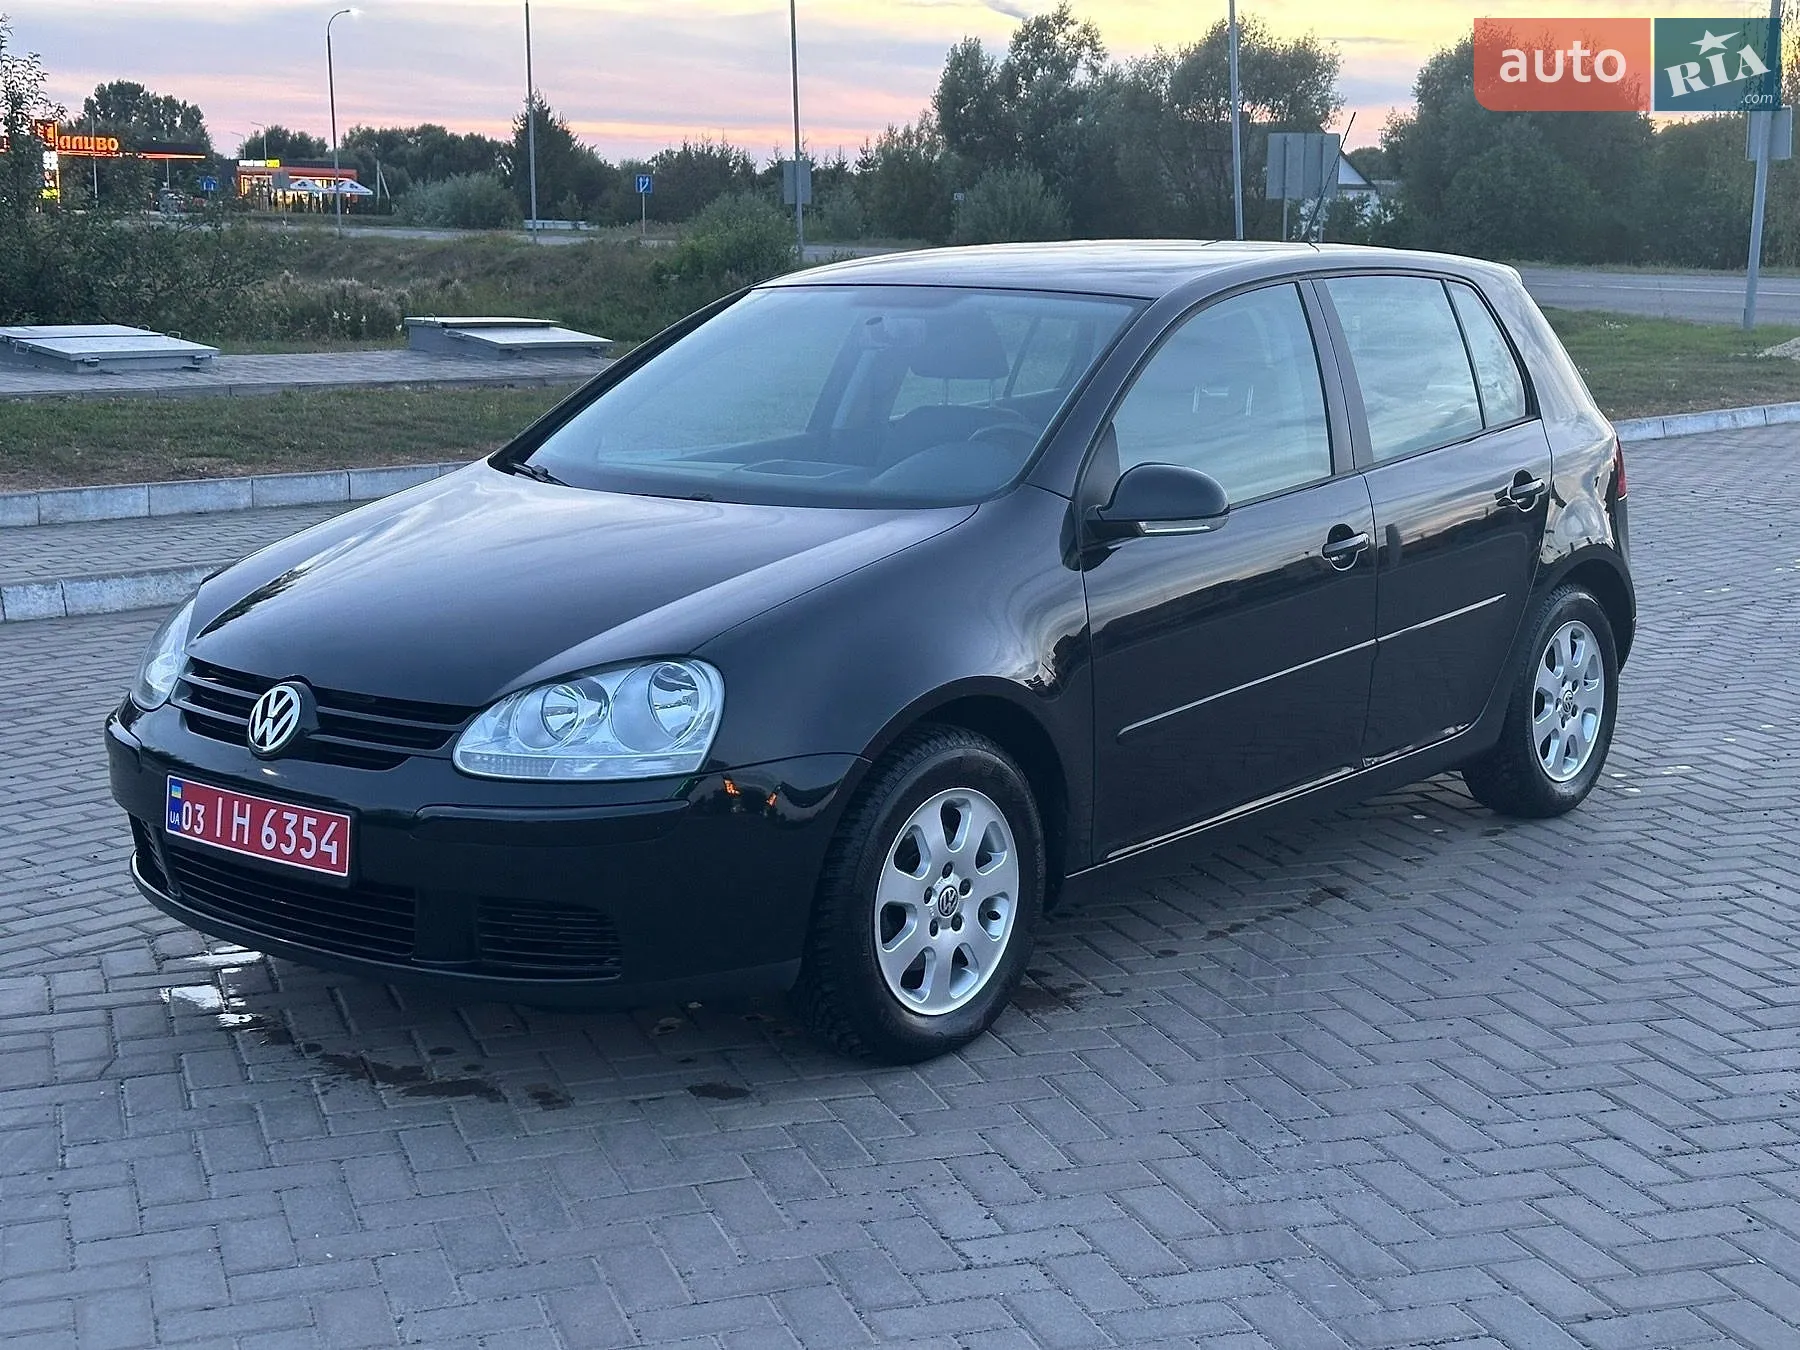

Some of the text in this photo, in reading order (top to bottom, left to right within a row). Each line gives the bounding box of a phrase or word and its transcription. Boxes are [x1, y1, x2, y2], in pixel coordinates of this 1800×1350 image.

[170, 811, 180, 826] UA
[181, 800, 205, 835] 03
[261, 808, 338, 865] 6354
